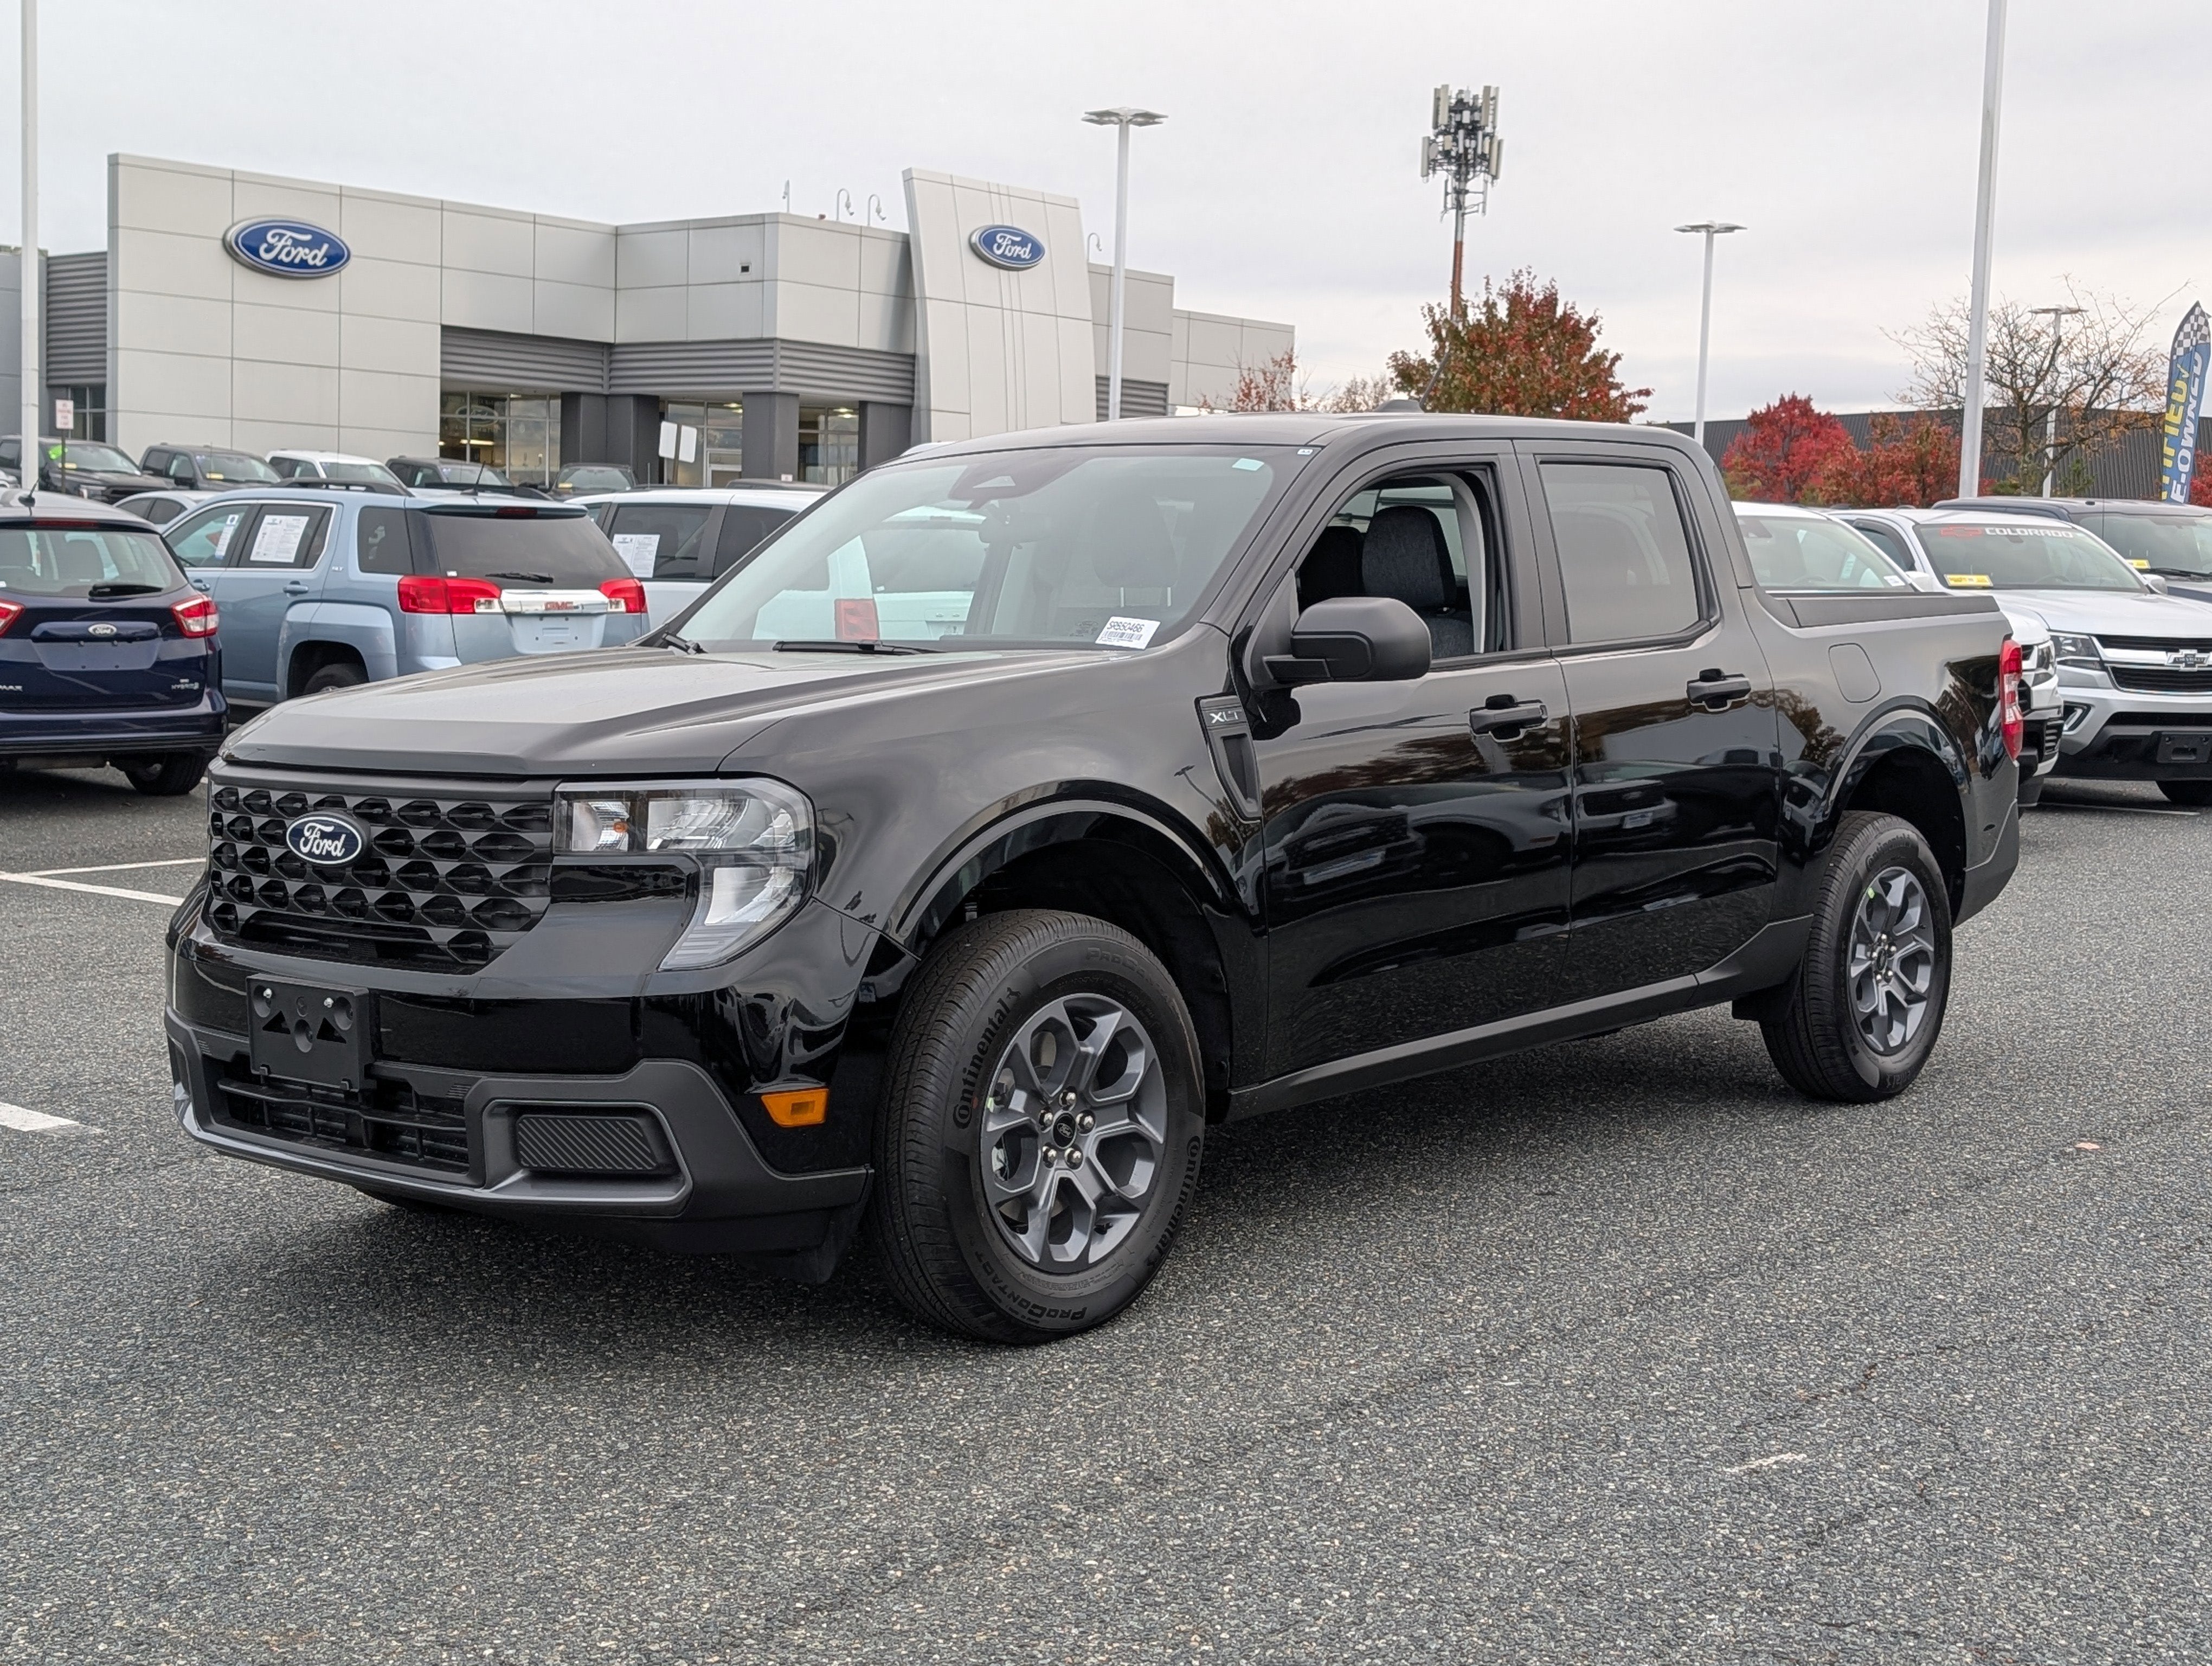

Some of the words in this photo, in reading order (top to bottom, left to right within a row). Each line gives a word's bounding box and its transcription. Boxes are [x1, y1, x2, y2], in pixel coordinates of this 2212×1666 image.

[259, 229, 329, 266] Ford
[993, 233, 1032, 259] Ford
[1985, 527, 2073, 538] COLORADO
[545, 601, 573, 611] GMC
[1210, 711, 1238, 724] XLT
[300, 823, 346, 857] Ford
[953, 998, 1011, 1129] Continental
